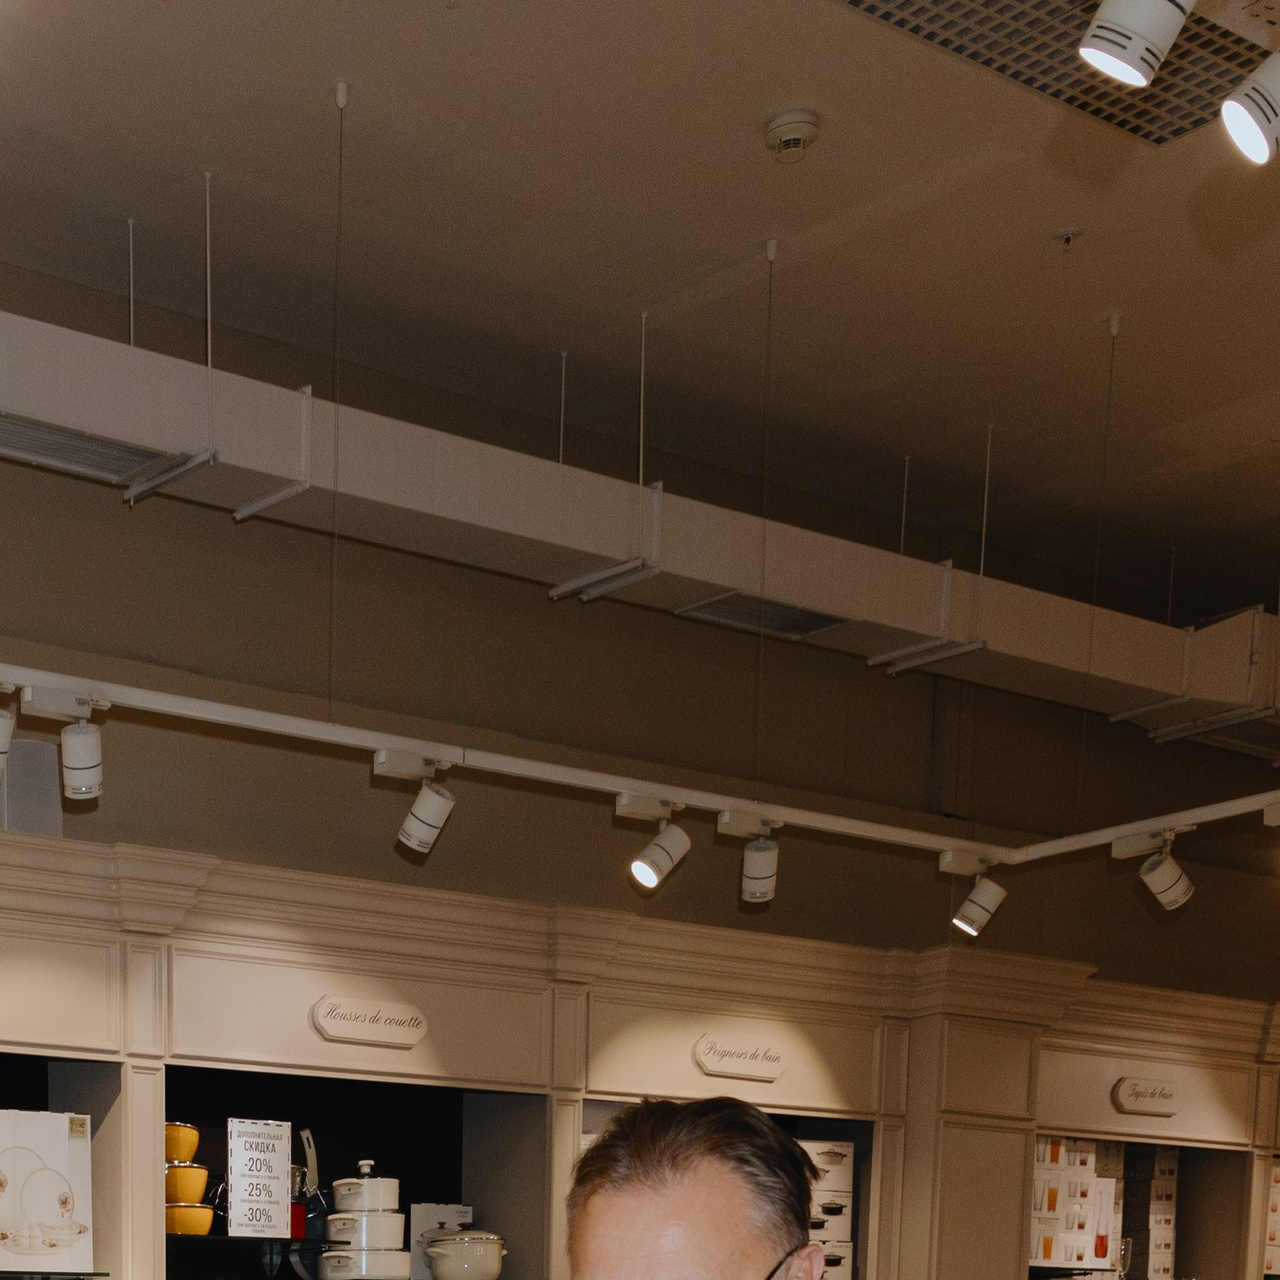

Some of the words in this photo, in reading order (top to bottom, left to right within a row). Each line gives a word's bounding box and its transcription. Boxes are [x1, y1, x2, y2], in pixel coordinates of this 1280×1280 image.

[323, 1002, 367, 1024] Housses
[369, 1009, 382, 1025] de
[384, 1016, 423, 1029] couette
[703, 1040, 748, 1062] Peignoirs
[749, 1047, 760, 1061] de
[760, 1047, 781, 1063] bain
[244, 1140, 276, 1154] СКИДКА
[244, 1157, 273, 1173] -20%
[244, 1182, 273, 1198] -25%
[244, 1207, 273, 1223] -30%
